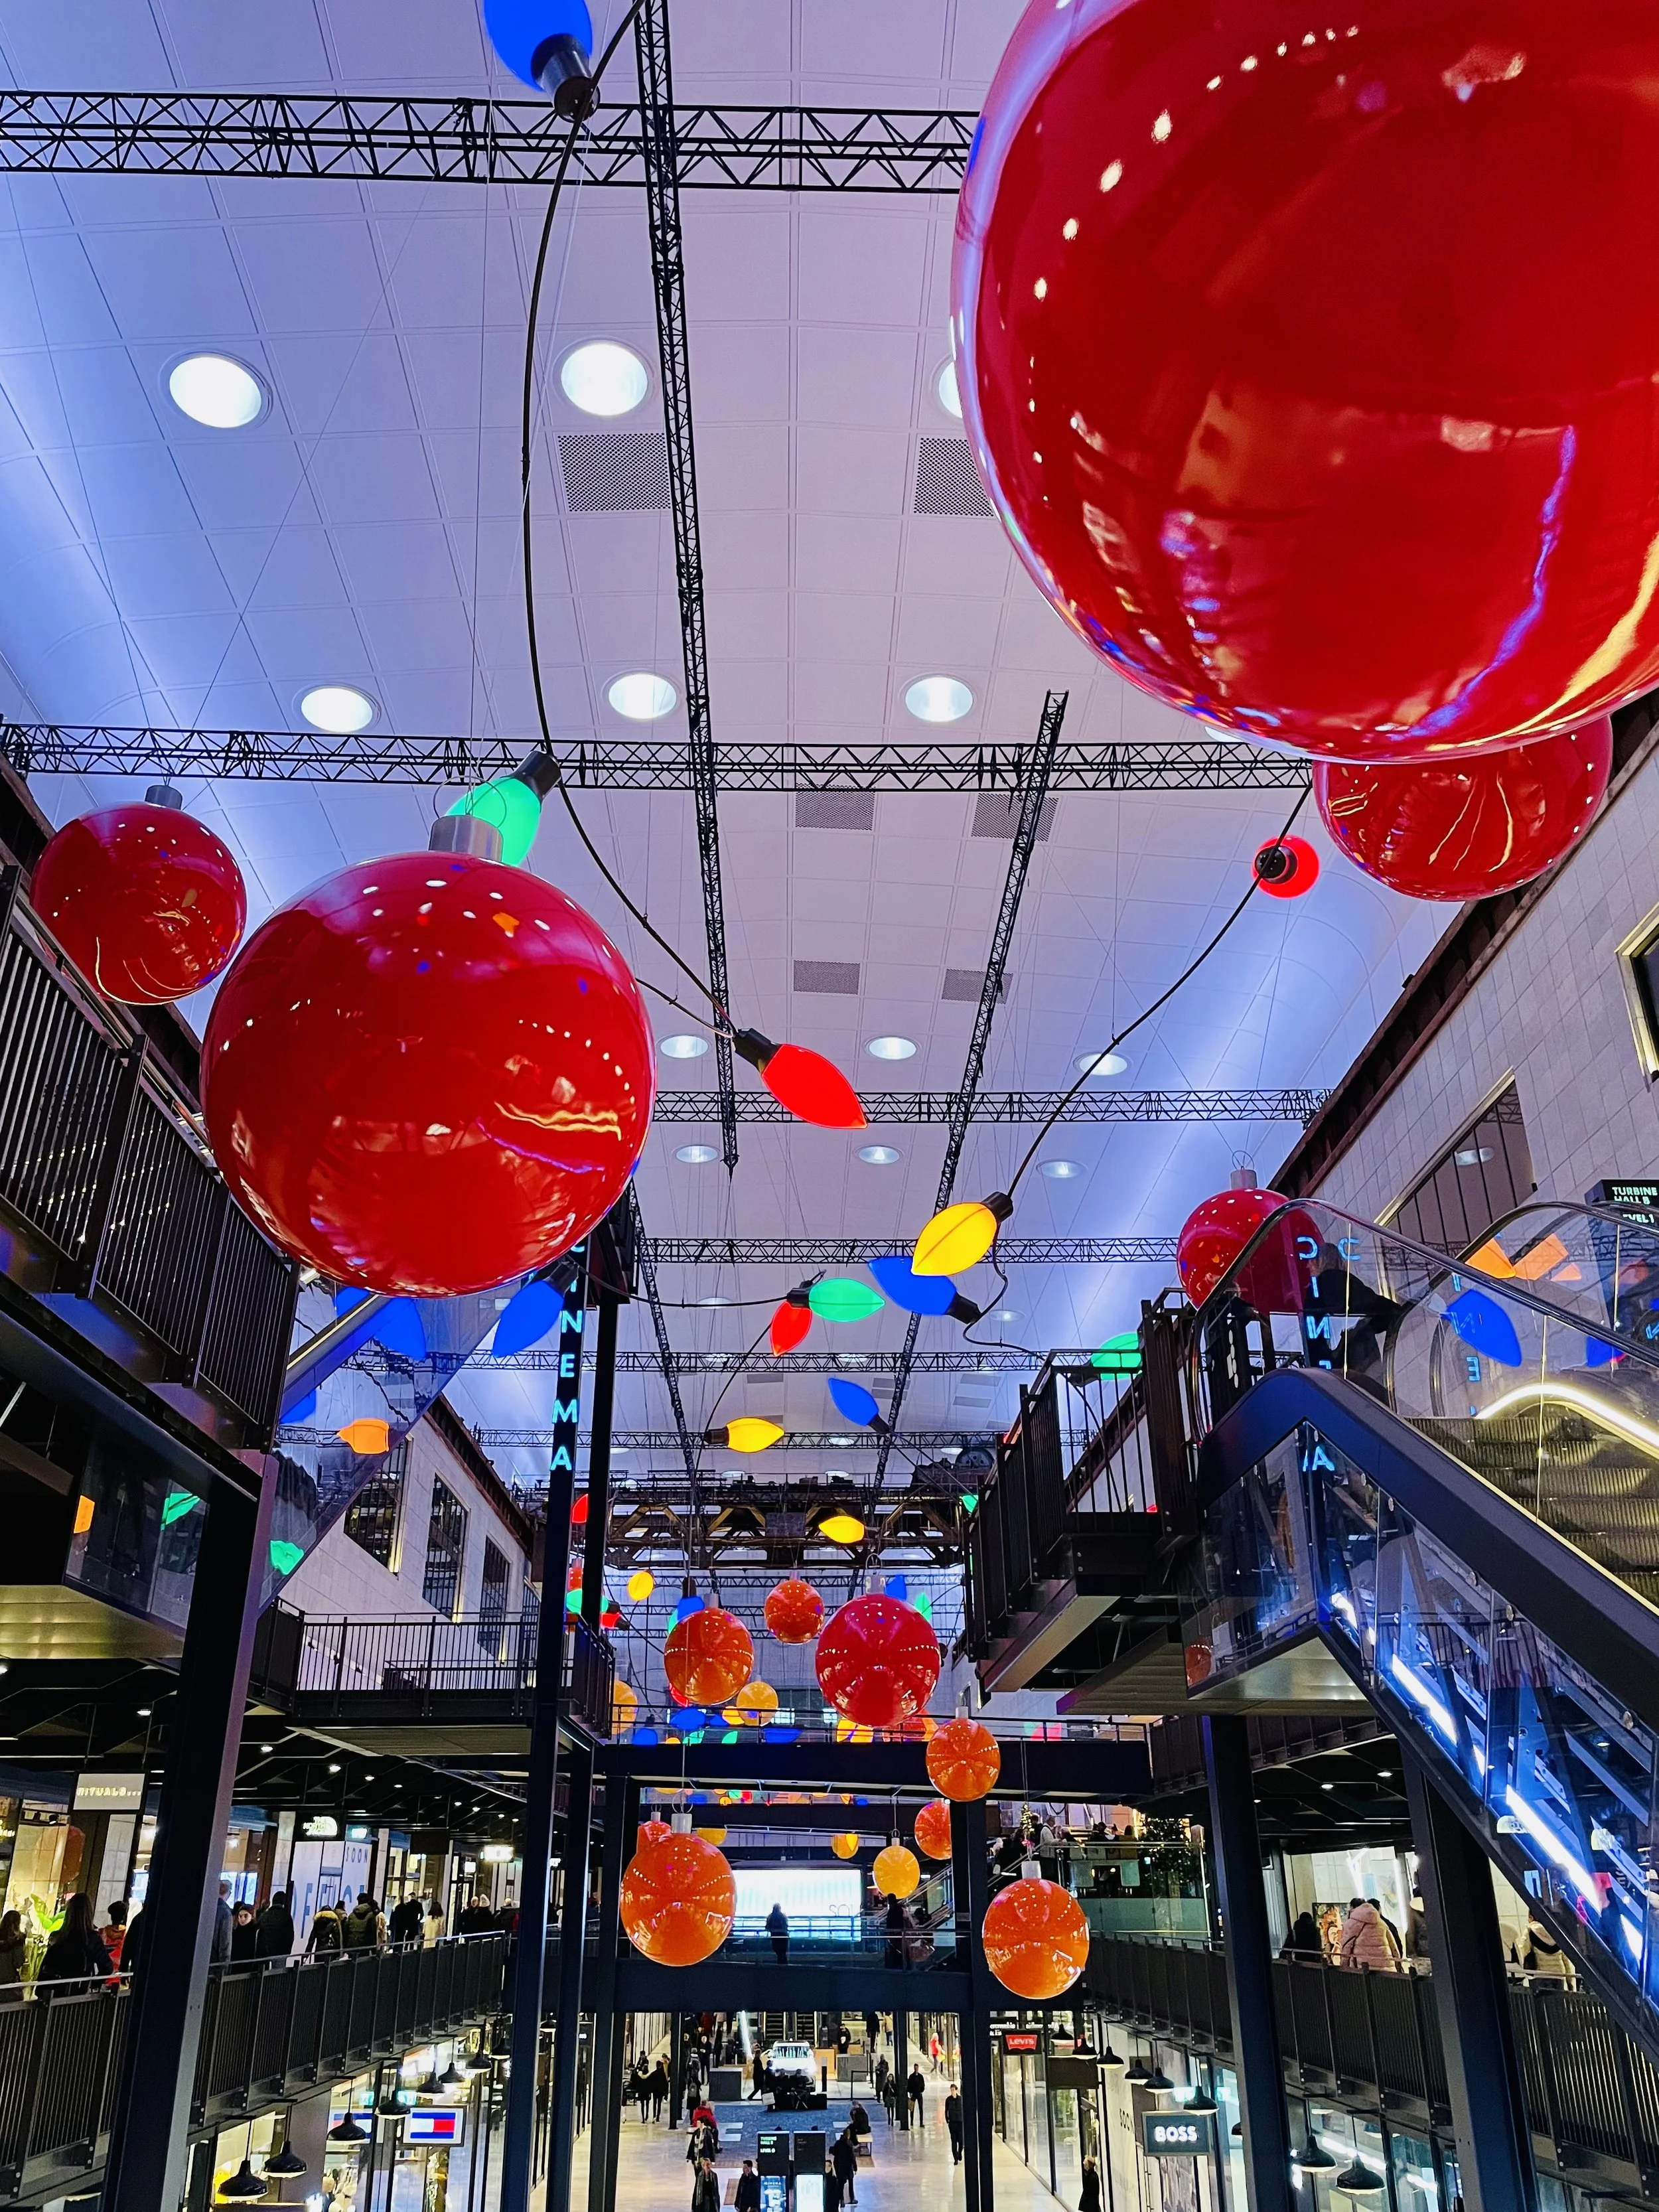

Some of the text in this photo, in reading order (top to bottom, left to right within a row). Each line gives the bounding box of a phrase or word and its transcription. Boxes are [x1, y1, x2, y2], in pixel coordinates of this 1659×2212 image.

[1612, 1187, 1658, 1196] TURBINE
[346, 1846, 368, 1864] SOON
[1155, 2125, 1198, 2143] BOSS
